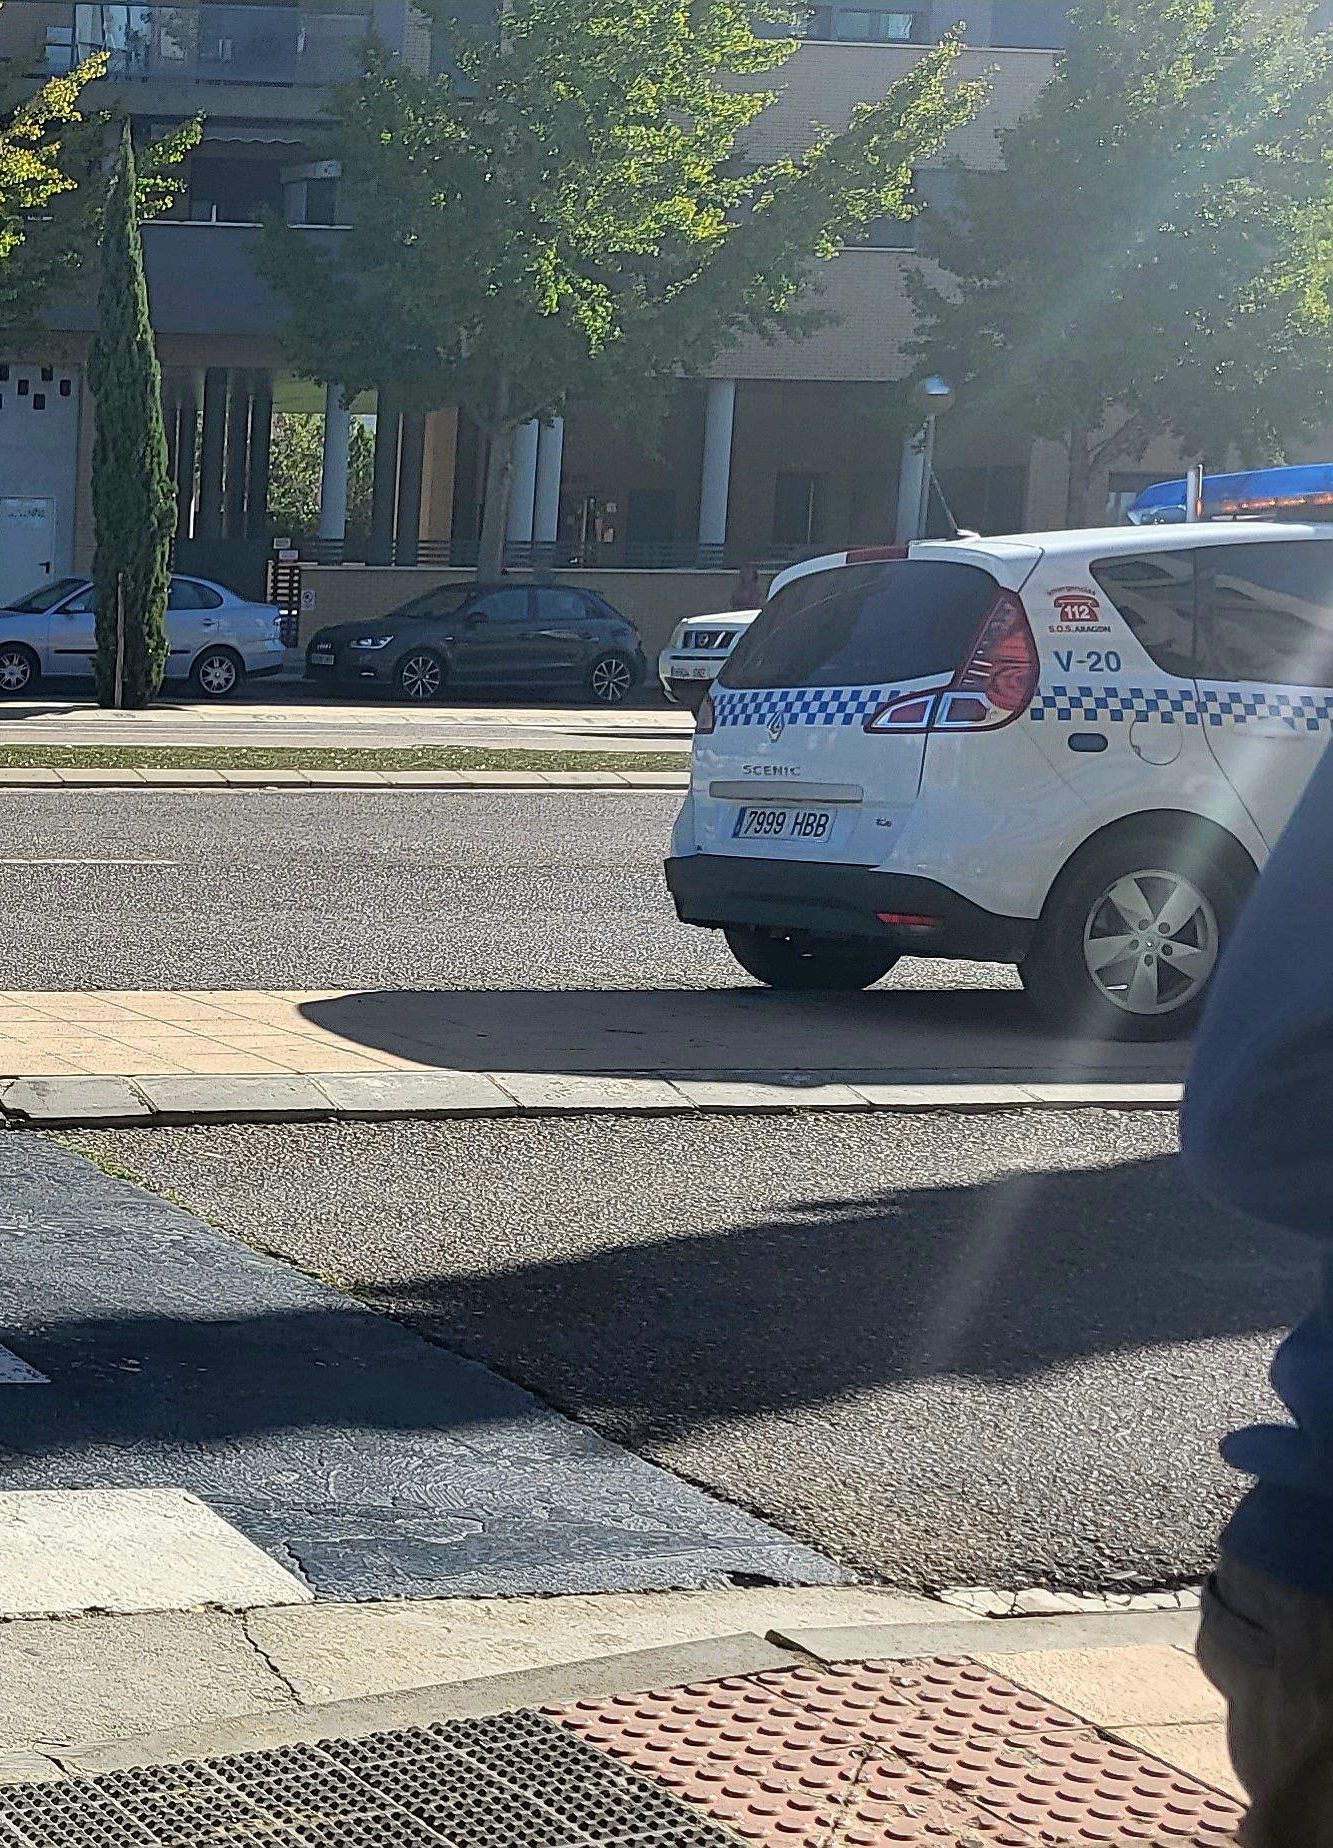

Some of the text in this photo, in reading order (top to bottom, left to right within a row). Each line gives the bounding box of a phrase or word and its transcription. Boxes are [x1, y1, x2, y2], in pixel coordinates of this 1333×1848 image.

[1064, 605, 1091, 620] 112
[1052, 650, 1122, 673] V-20
[742, 764, 801, 776] SCENIC
[743, 810, 830, 838] 7999 HBB
